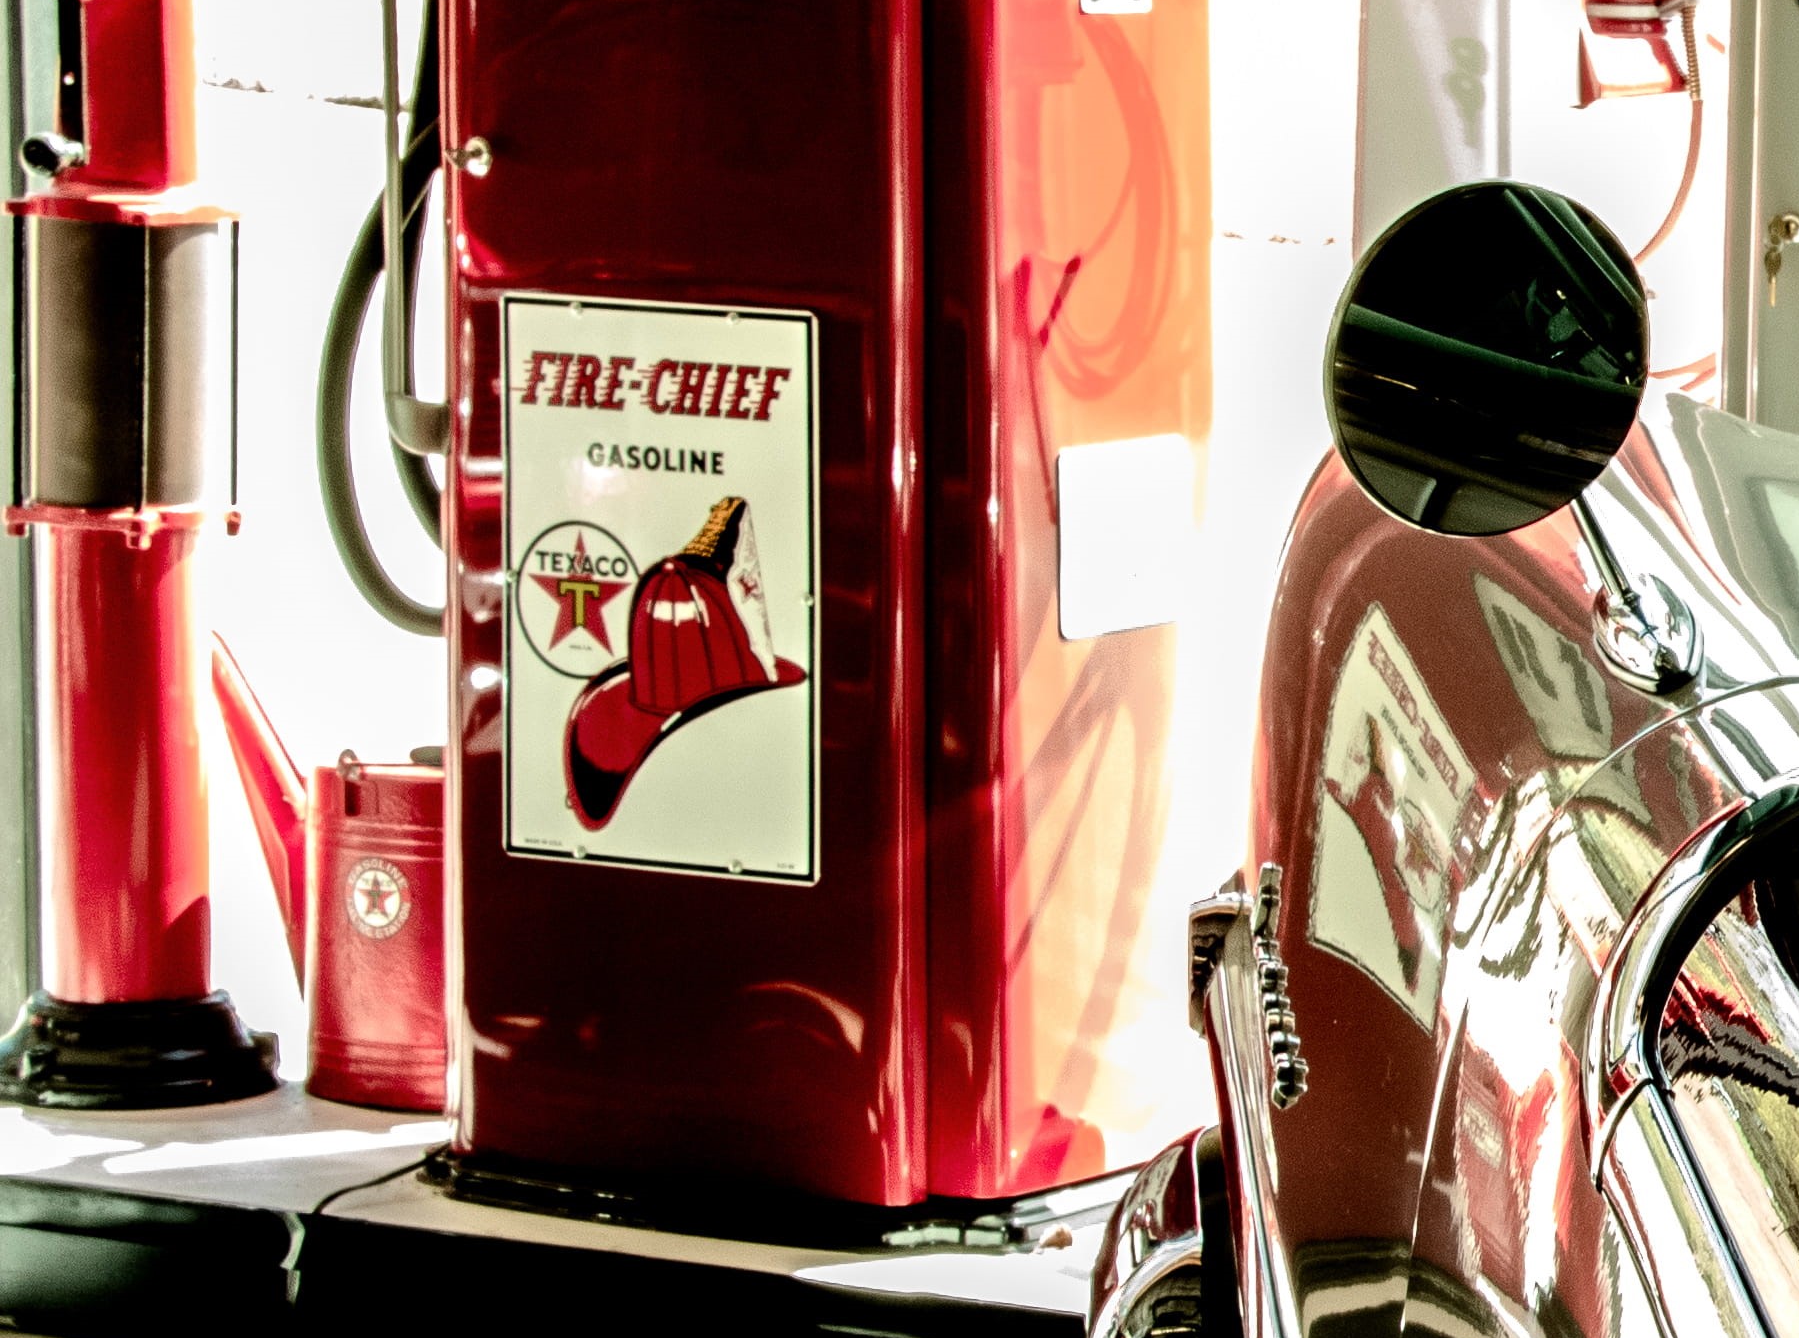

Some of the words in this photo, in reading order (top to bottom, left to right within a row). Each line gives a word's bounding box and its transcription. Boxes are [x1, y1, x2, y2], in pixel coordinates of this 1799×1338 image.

[515, 350, 791, 422] FIRE-CHIEF
[587, 442, 725, 475] GASOLINE
[535, 549, 629, 578] TEXACO
